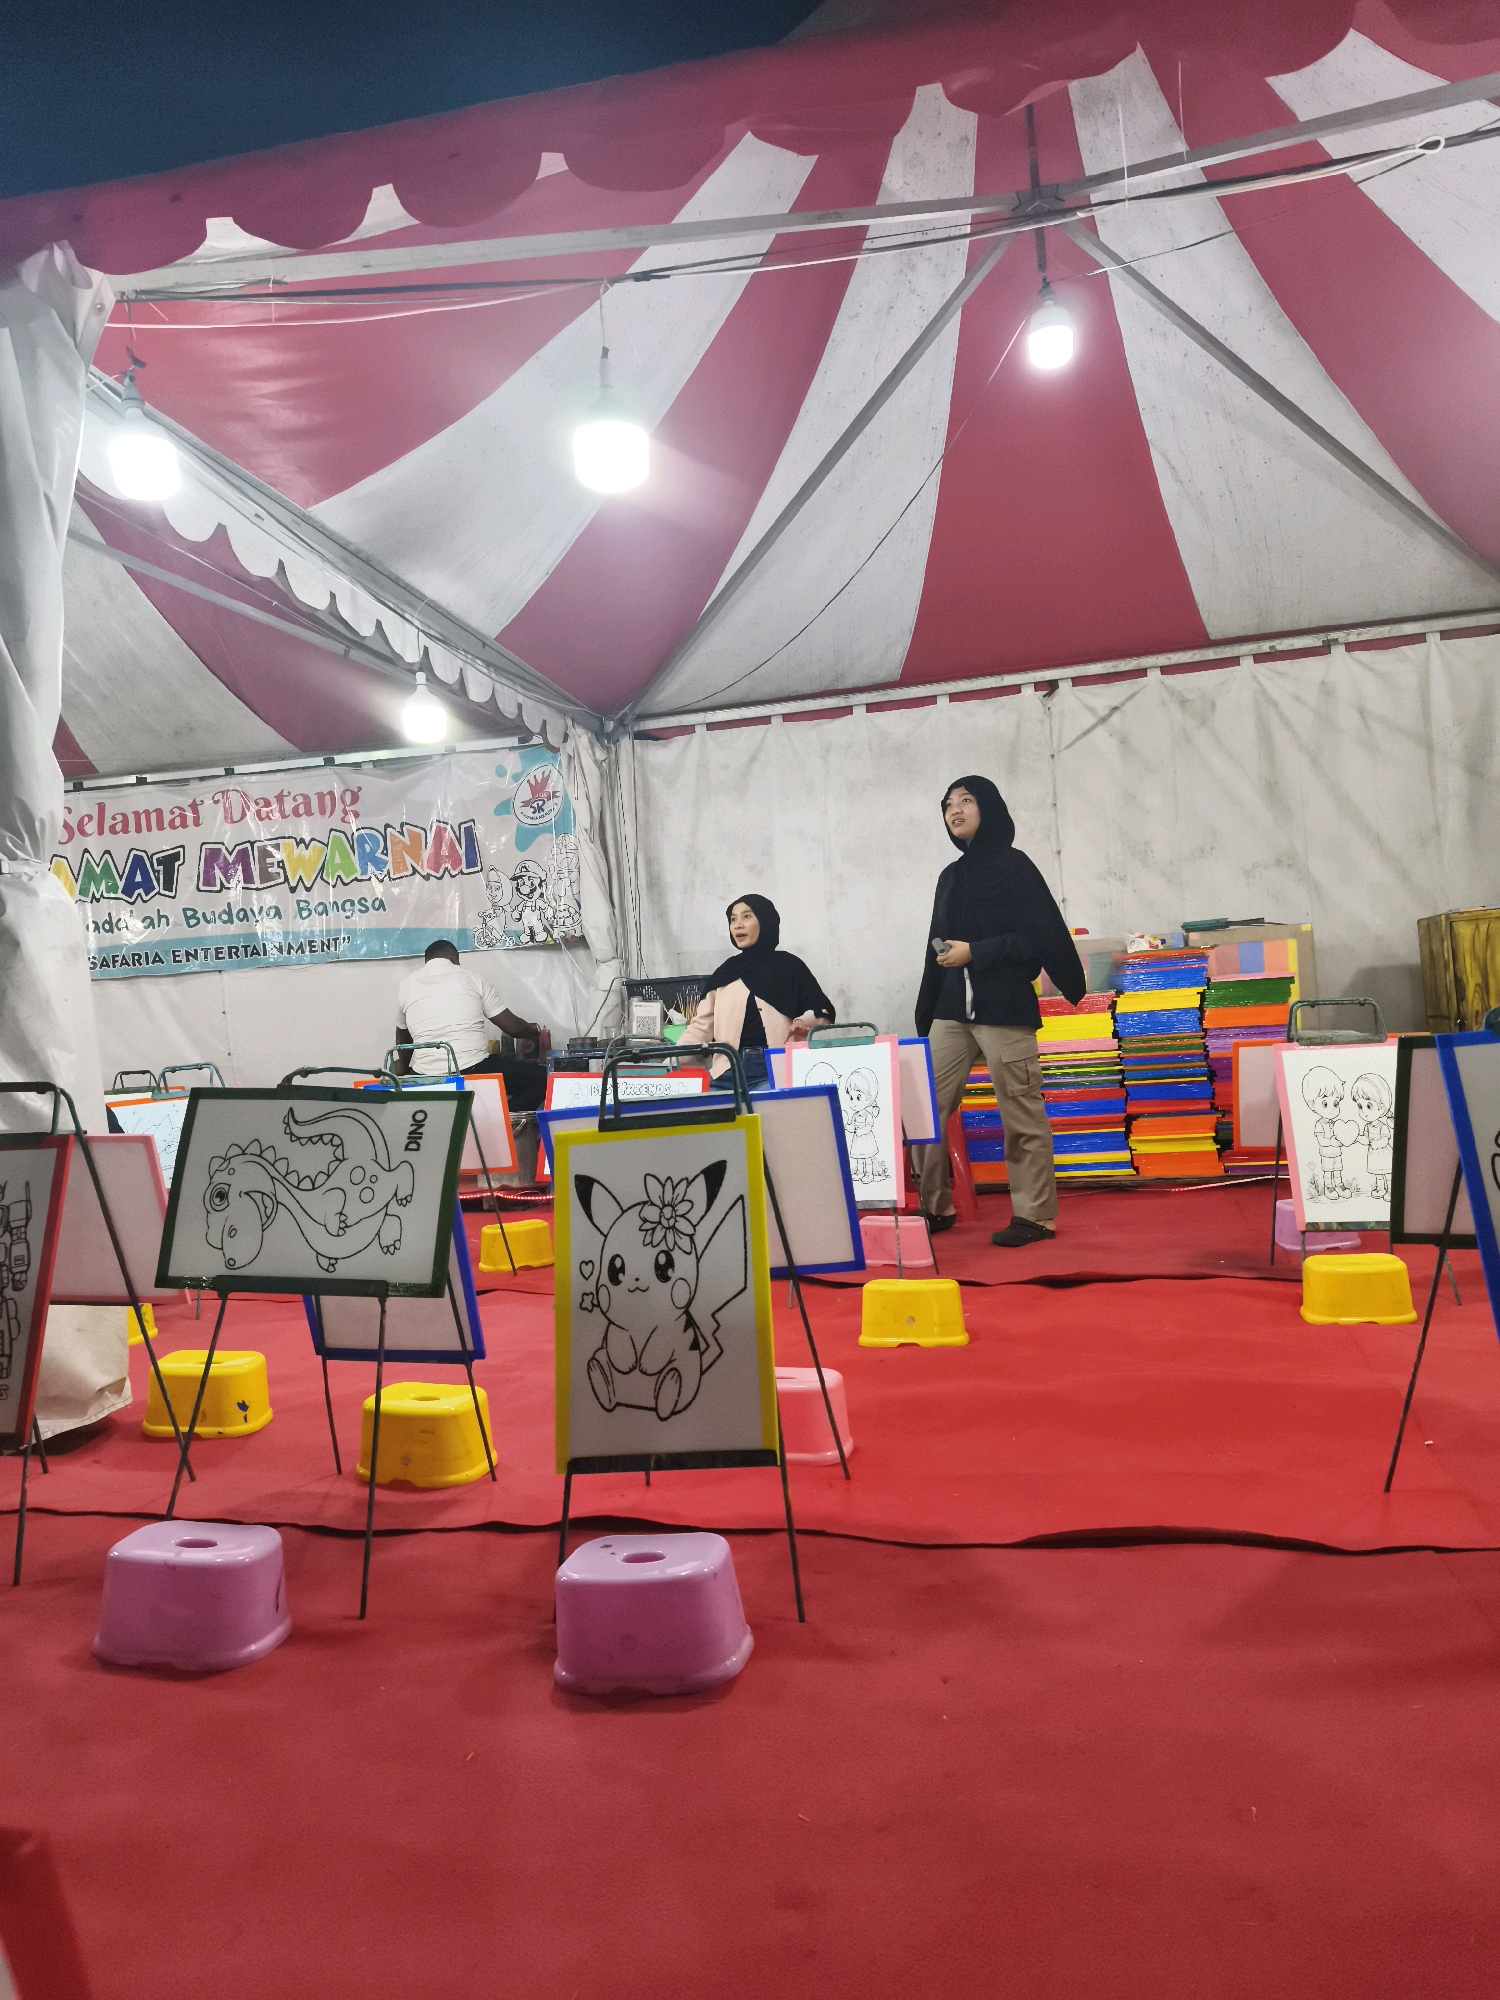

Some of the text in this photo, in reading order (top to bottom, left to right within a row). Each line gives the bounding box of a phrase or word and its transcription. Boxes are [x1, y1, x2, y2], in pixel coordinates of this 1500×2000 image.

[58, 786, 362, 845] Selamat Datang
[196, 819, 483, 893] MEWARNAI
[181, 902, 283, 928] Budaya
[296, 896, 387, 920] Bangsa
[89, 950, 165, 971] SAFARIA
[404, 1109, 428, 1152] DINO
